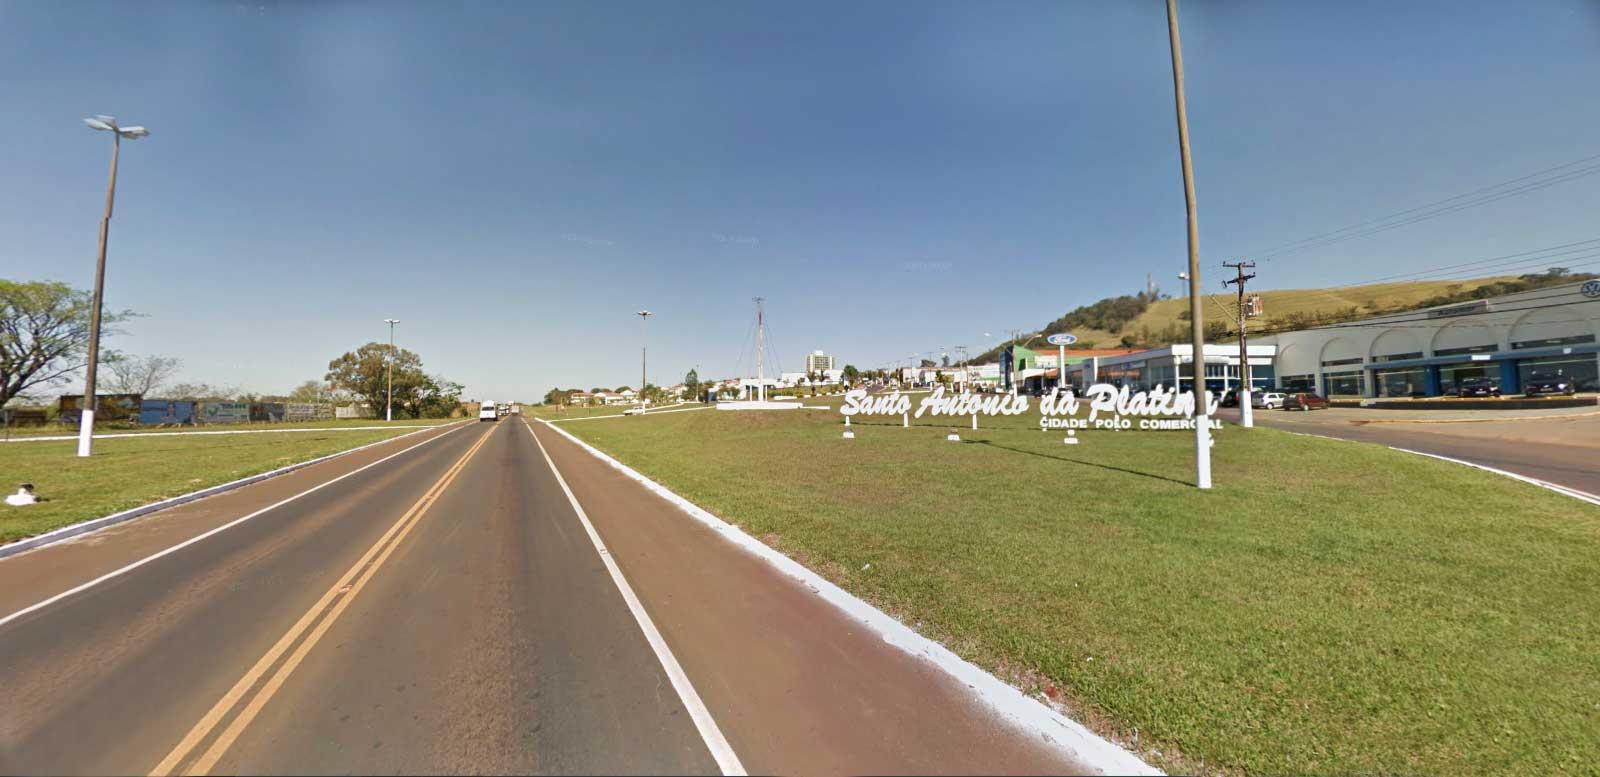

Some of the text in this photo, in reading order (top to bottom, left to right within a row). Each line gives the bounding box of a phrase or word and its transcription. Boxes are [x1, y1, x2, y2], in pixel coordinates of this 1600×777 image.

[840, 389, 912, 416] Santo
[914, 386, 1030, 418] Antonio
[1040, 386, 1080, 416] da
[1040, 418, 1223, 430] CIDADE POLO COMERCAL
